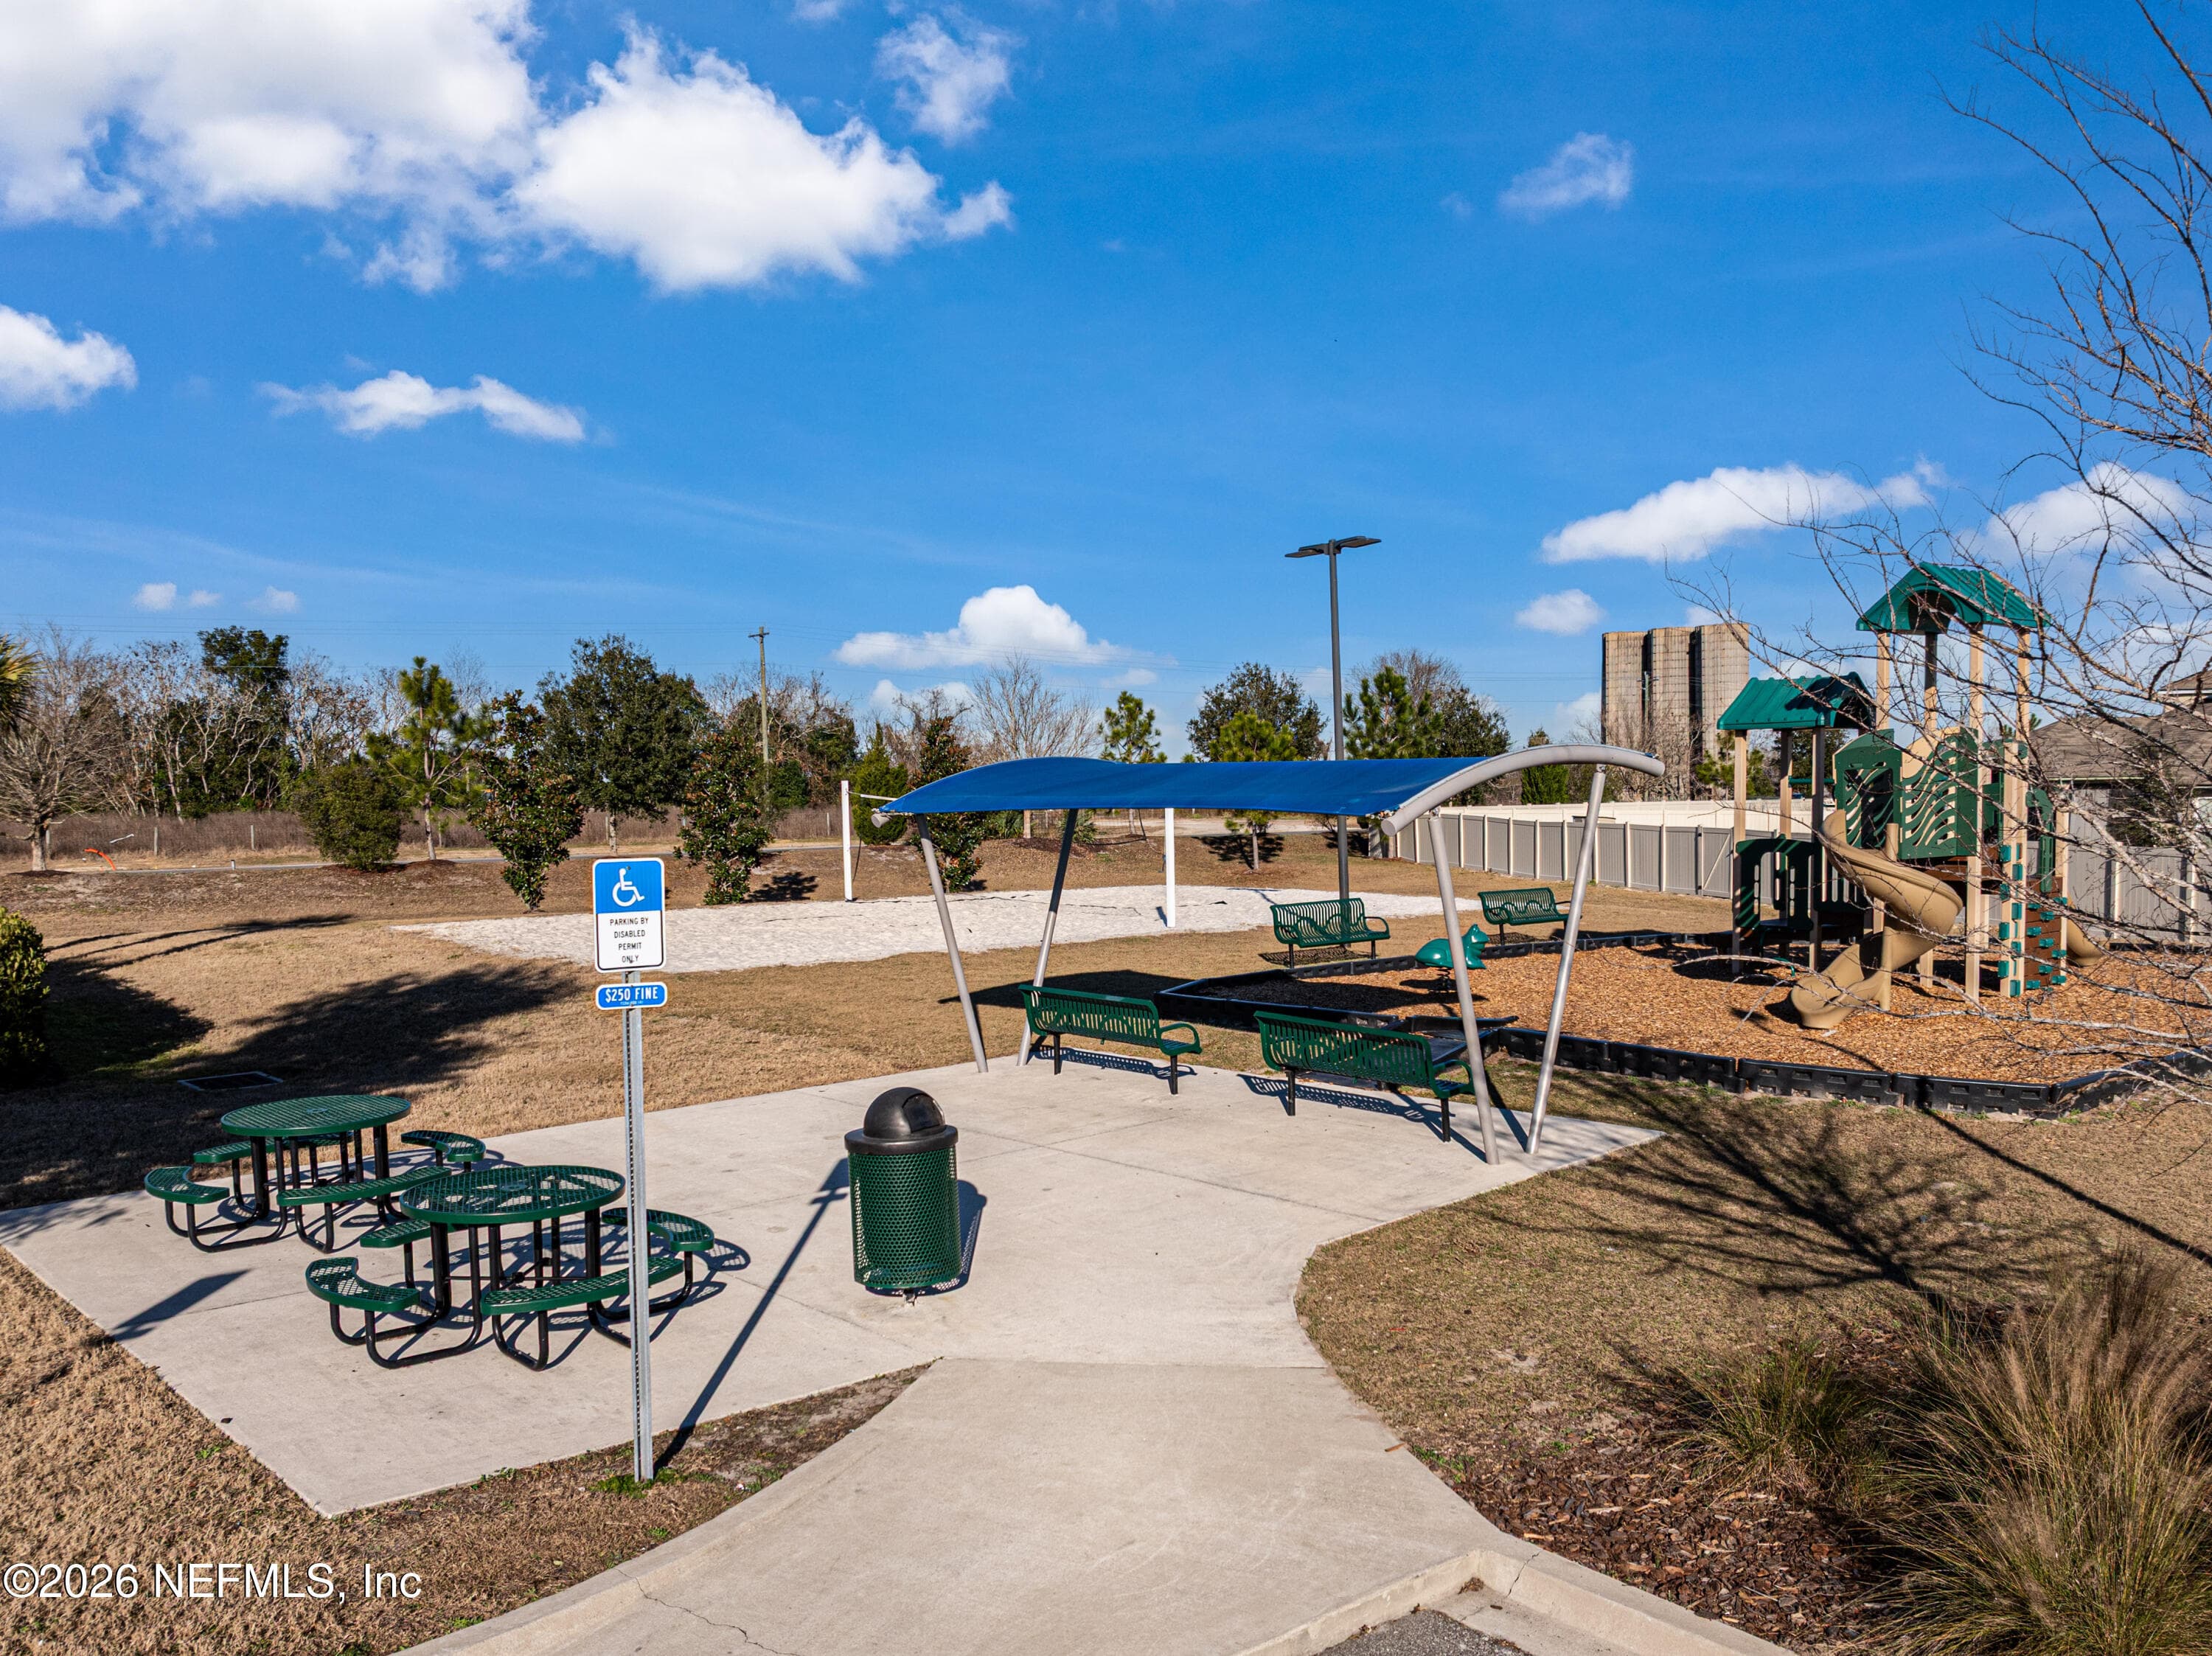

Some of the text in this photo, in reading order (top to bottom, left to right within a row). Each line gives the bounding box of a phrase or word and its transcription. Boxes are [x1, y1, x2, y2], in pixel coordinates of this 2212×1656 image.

[610, 918, 639, 926] PARKING
[614, 930, 646, 939] DISABLED
[619, 942, 642, 950] PERMIT
[605, 987, 658, 1003] $250 FINE
